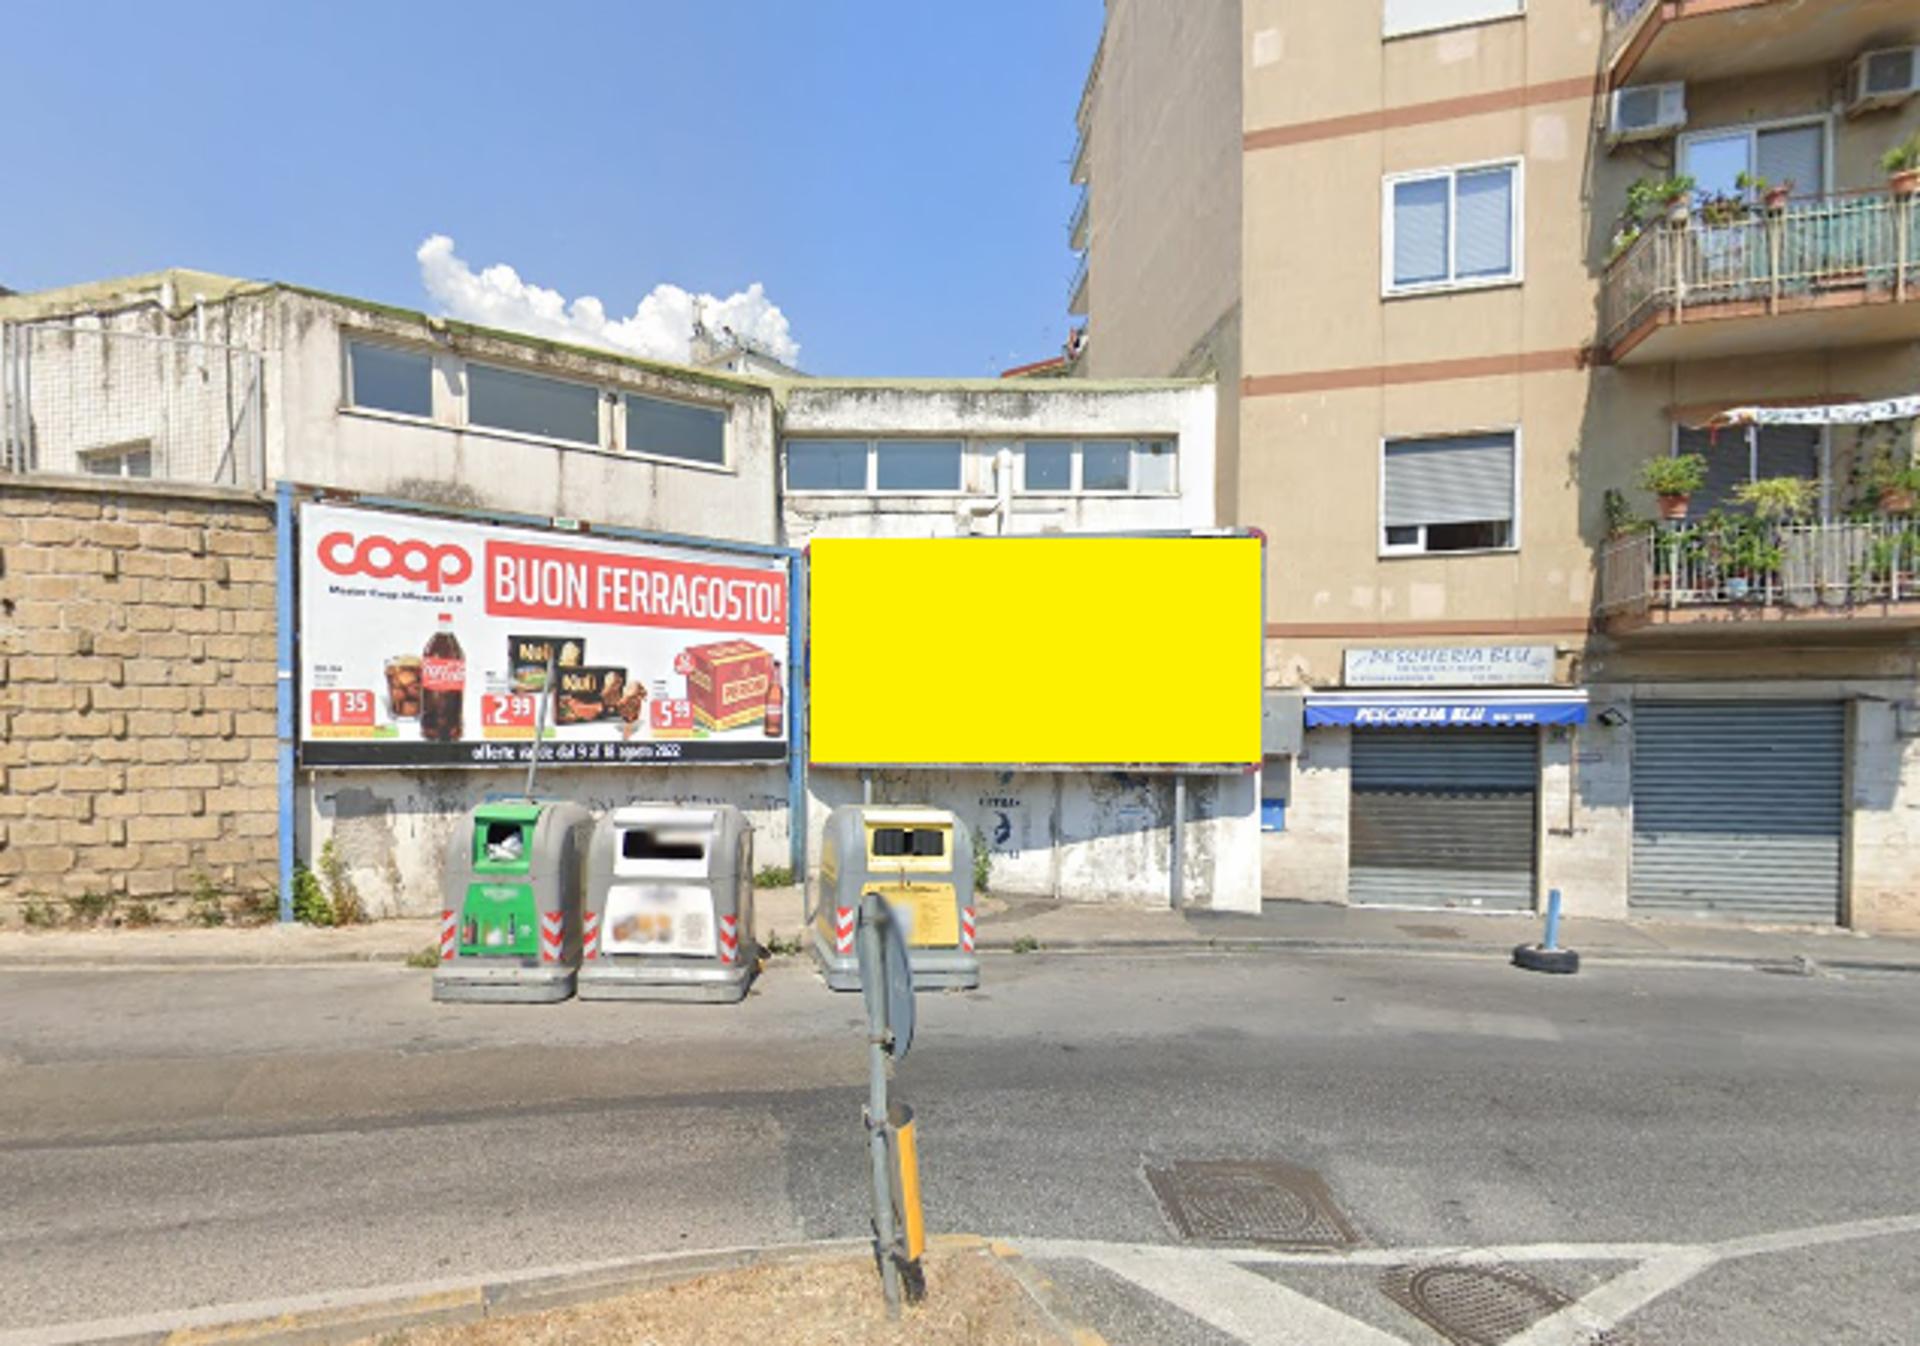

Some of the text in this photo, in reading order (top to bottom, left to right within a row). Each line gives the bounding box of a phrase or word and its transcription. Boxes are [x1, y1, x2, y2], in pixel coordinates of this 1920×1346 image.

[317, 531, 473, 593] coop
[494, 555, 781, 624] BUON FERRAGOSTO!
[1355, 706, 1446, 722] PESCHERIA
[1451, 706, 1486, 721] BLU
